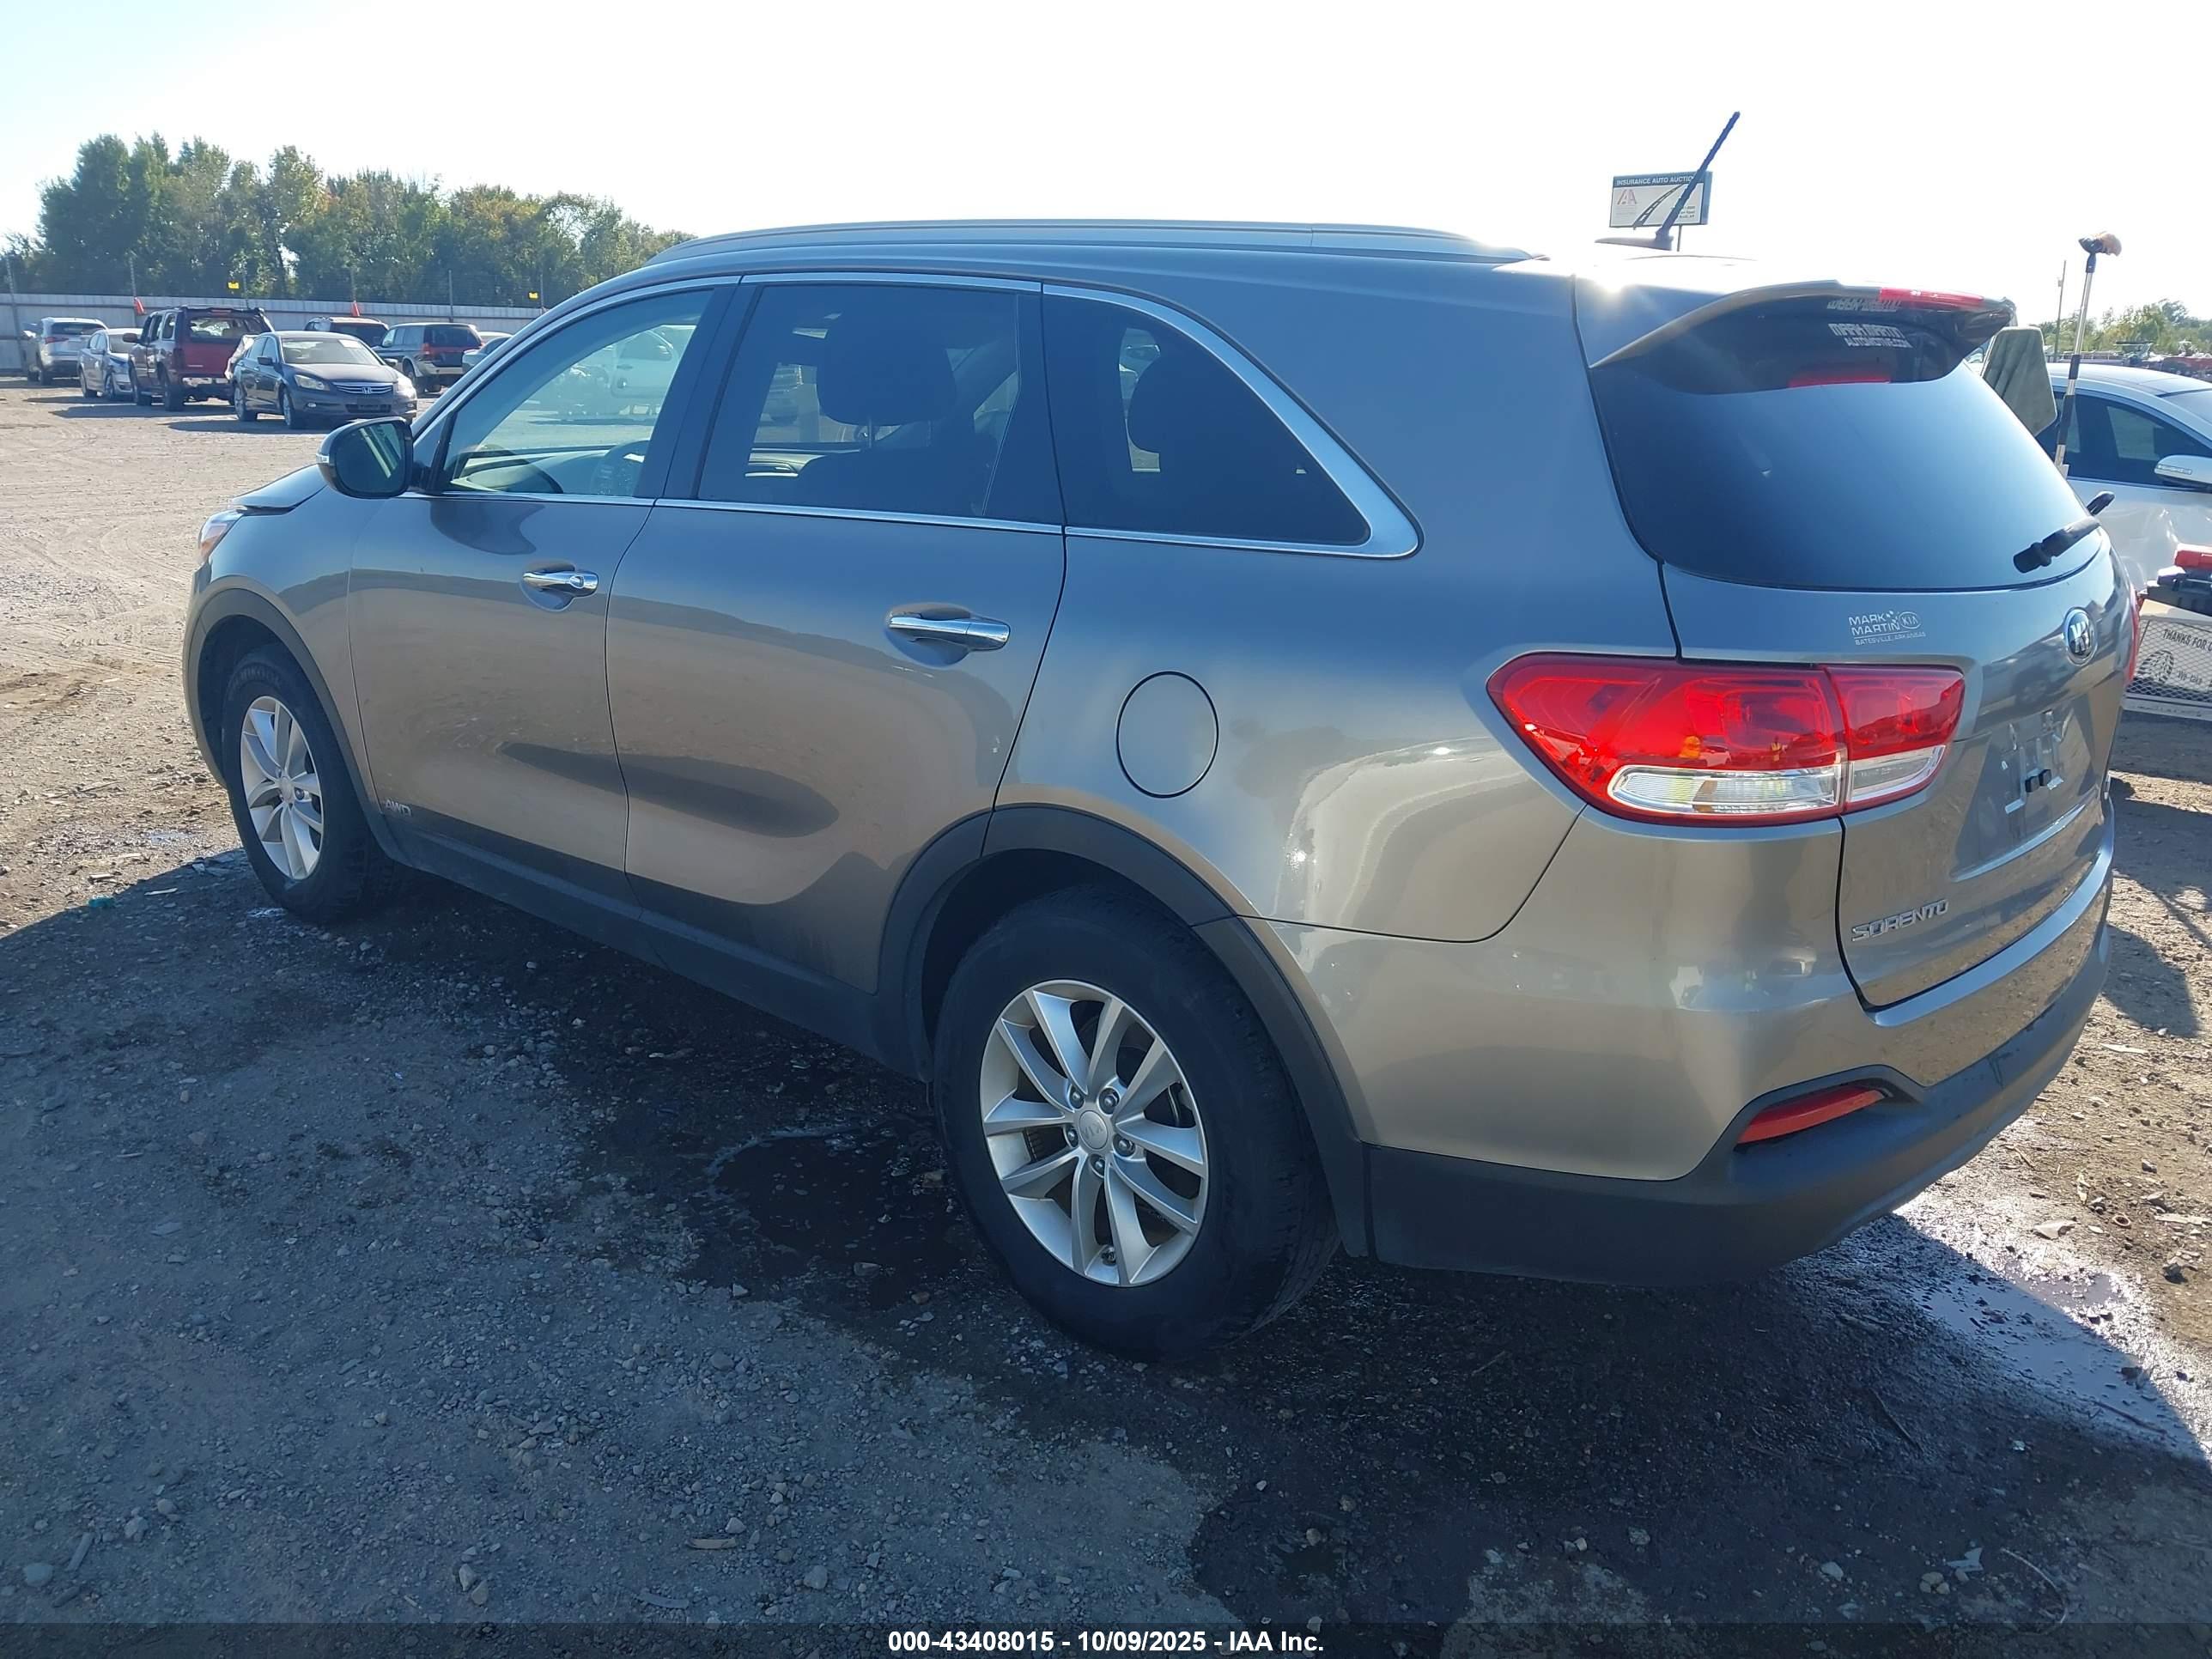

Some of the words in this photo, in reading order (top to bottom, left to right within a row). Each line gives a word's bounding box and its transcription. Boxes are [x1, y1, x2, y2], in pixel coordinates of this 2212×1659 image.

[1616, 178, 1651, 186] INSURANCE
[1651, 175, 1669, 184] AUTO
[1848, 613, 1887, 625] MARK
[1851, 622, 1900, 636] MARTIN
[2162, 629, 2191, 646] THANKS
[2191, 637, 2208, 651] FOR
[385, 799, 412, 817] AWD
[1851, 898, 1949, 942] SORENTO
